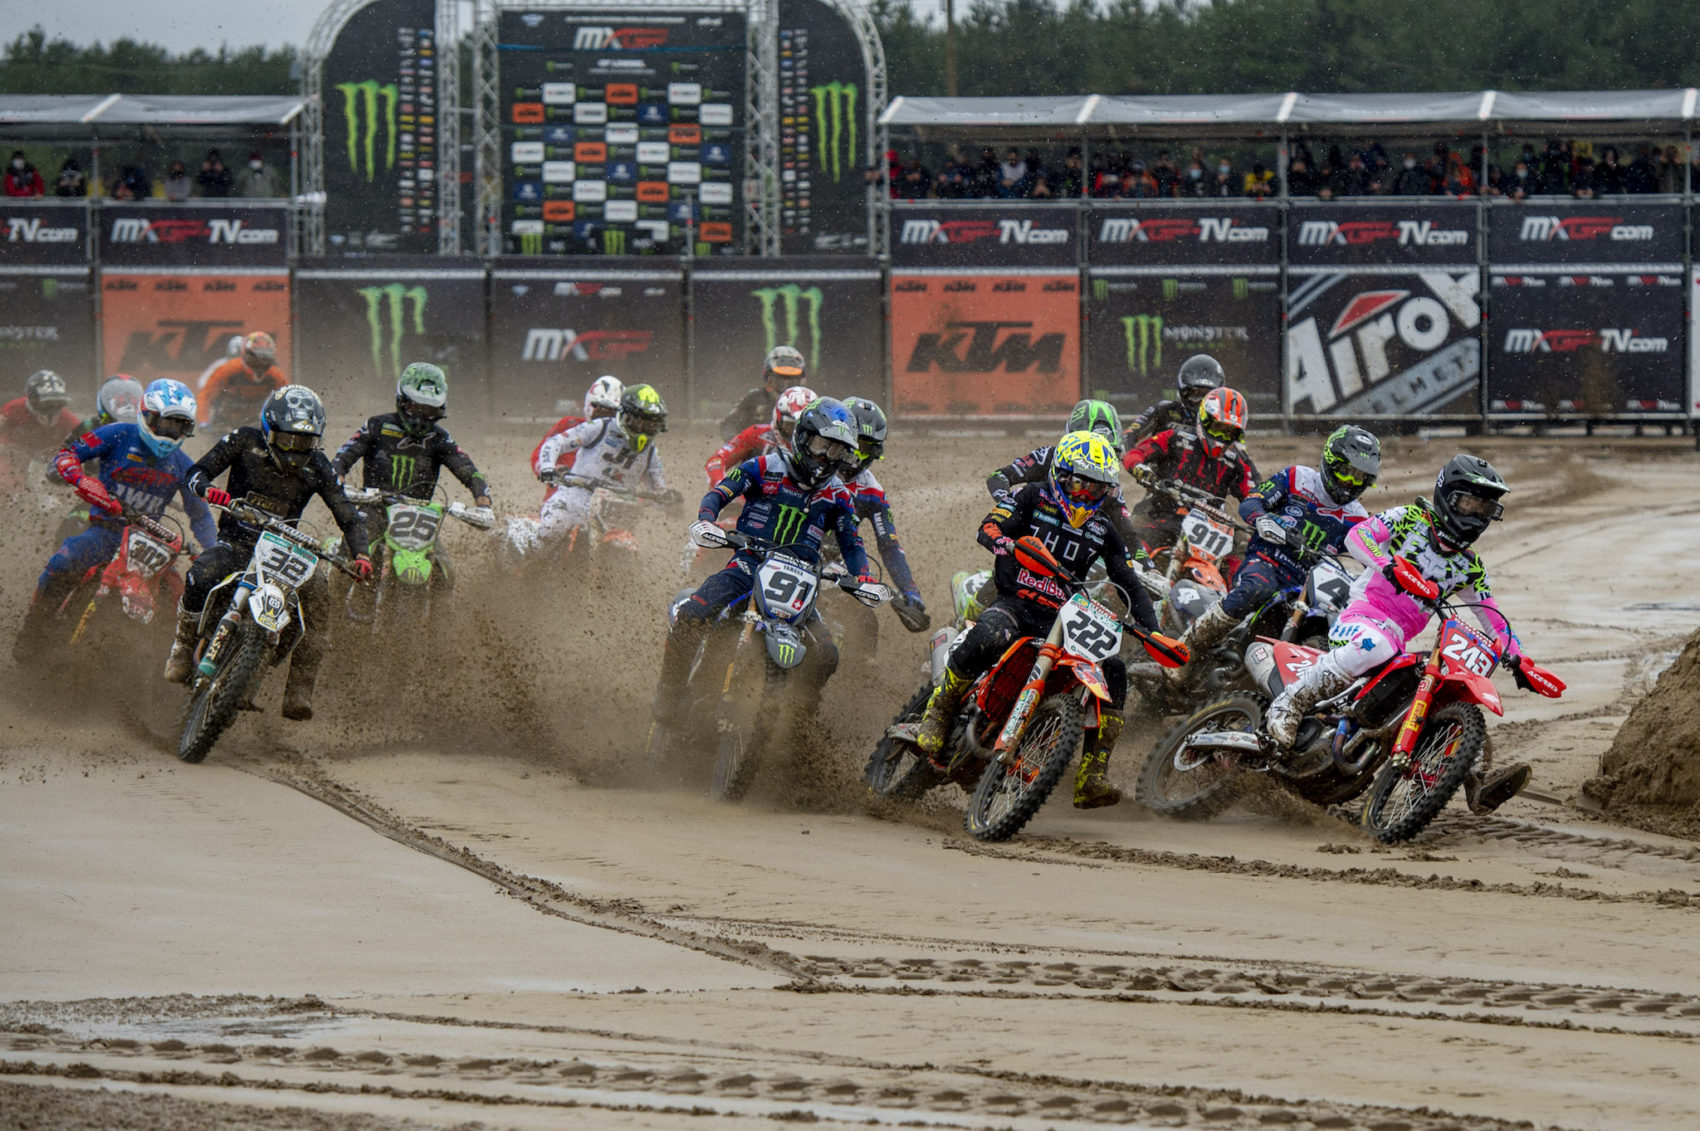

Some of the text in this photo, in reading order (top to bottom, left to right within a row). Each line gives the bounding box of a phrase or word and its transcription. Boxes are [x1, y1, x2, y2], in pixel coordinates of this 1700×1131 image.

[906, 321, 1066, 373] KTM
[388, 511, 436, 541] 25
[1188, 523, 1228, 556] 911
[261, 547, 309, 585] 32
[764, 571, 814, 604] 91
[1017, 568, 1067, 600] Red Bu
[1317, 578, 1350, 610] 4
[1402, 571, 1430, 595] ACERBIS
[1066, 610, 1117, 659] 222
[1442, 633, 1493, 678] 243
[1527, 670, 1558, 692] ACERBIS
